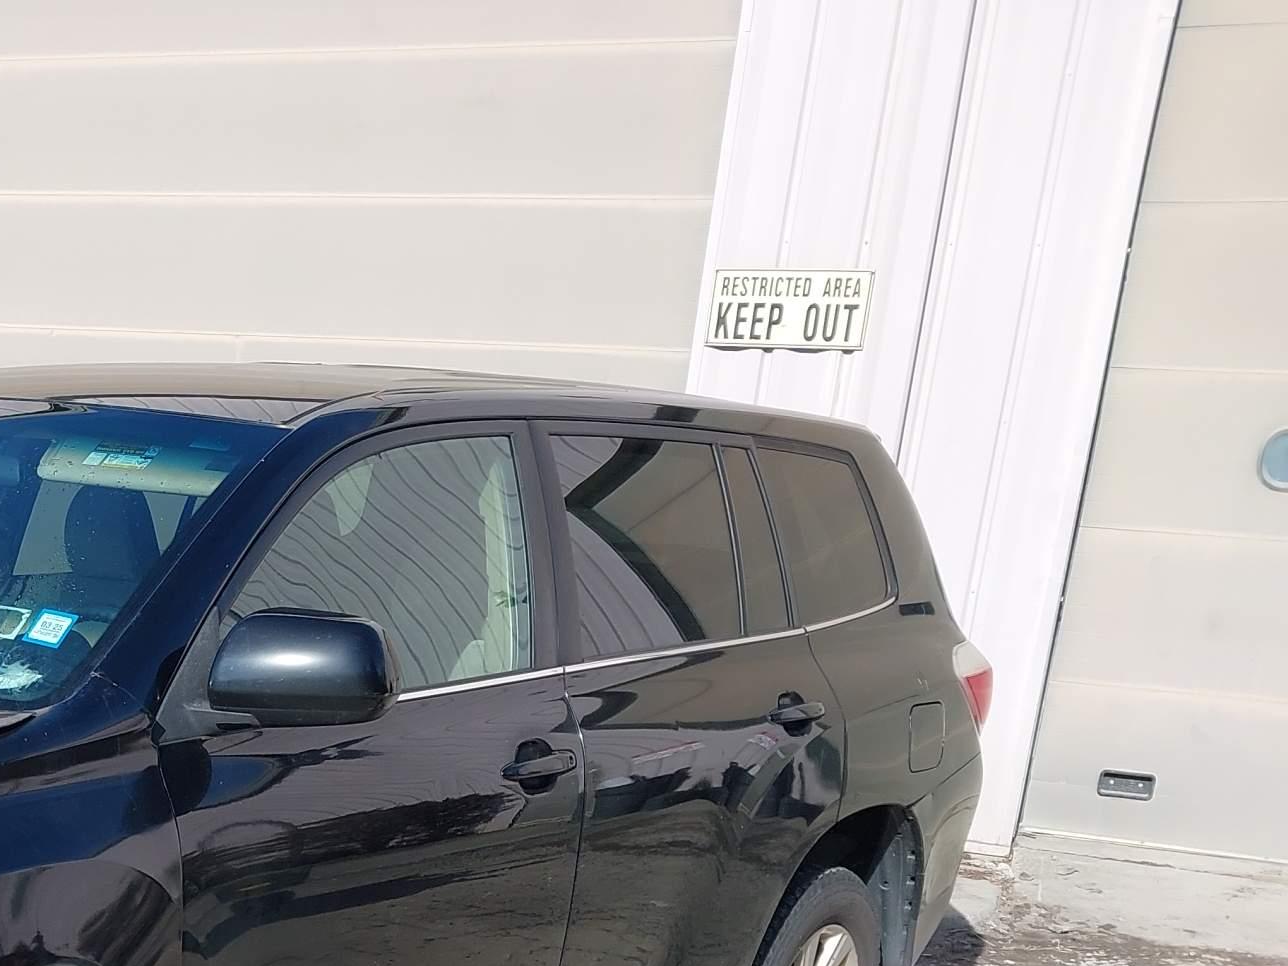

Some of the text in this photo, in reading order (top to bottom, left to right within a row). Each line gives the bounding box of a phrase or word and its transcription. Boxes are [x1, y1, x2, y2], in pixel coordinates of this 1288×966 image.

[721, 277, 862, 298] RESTRICTED AREA
[714, 302, 861, 342] KEEP OUT
